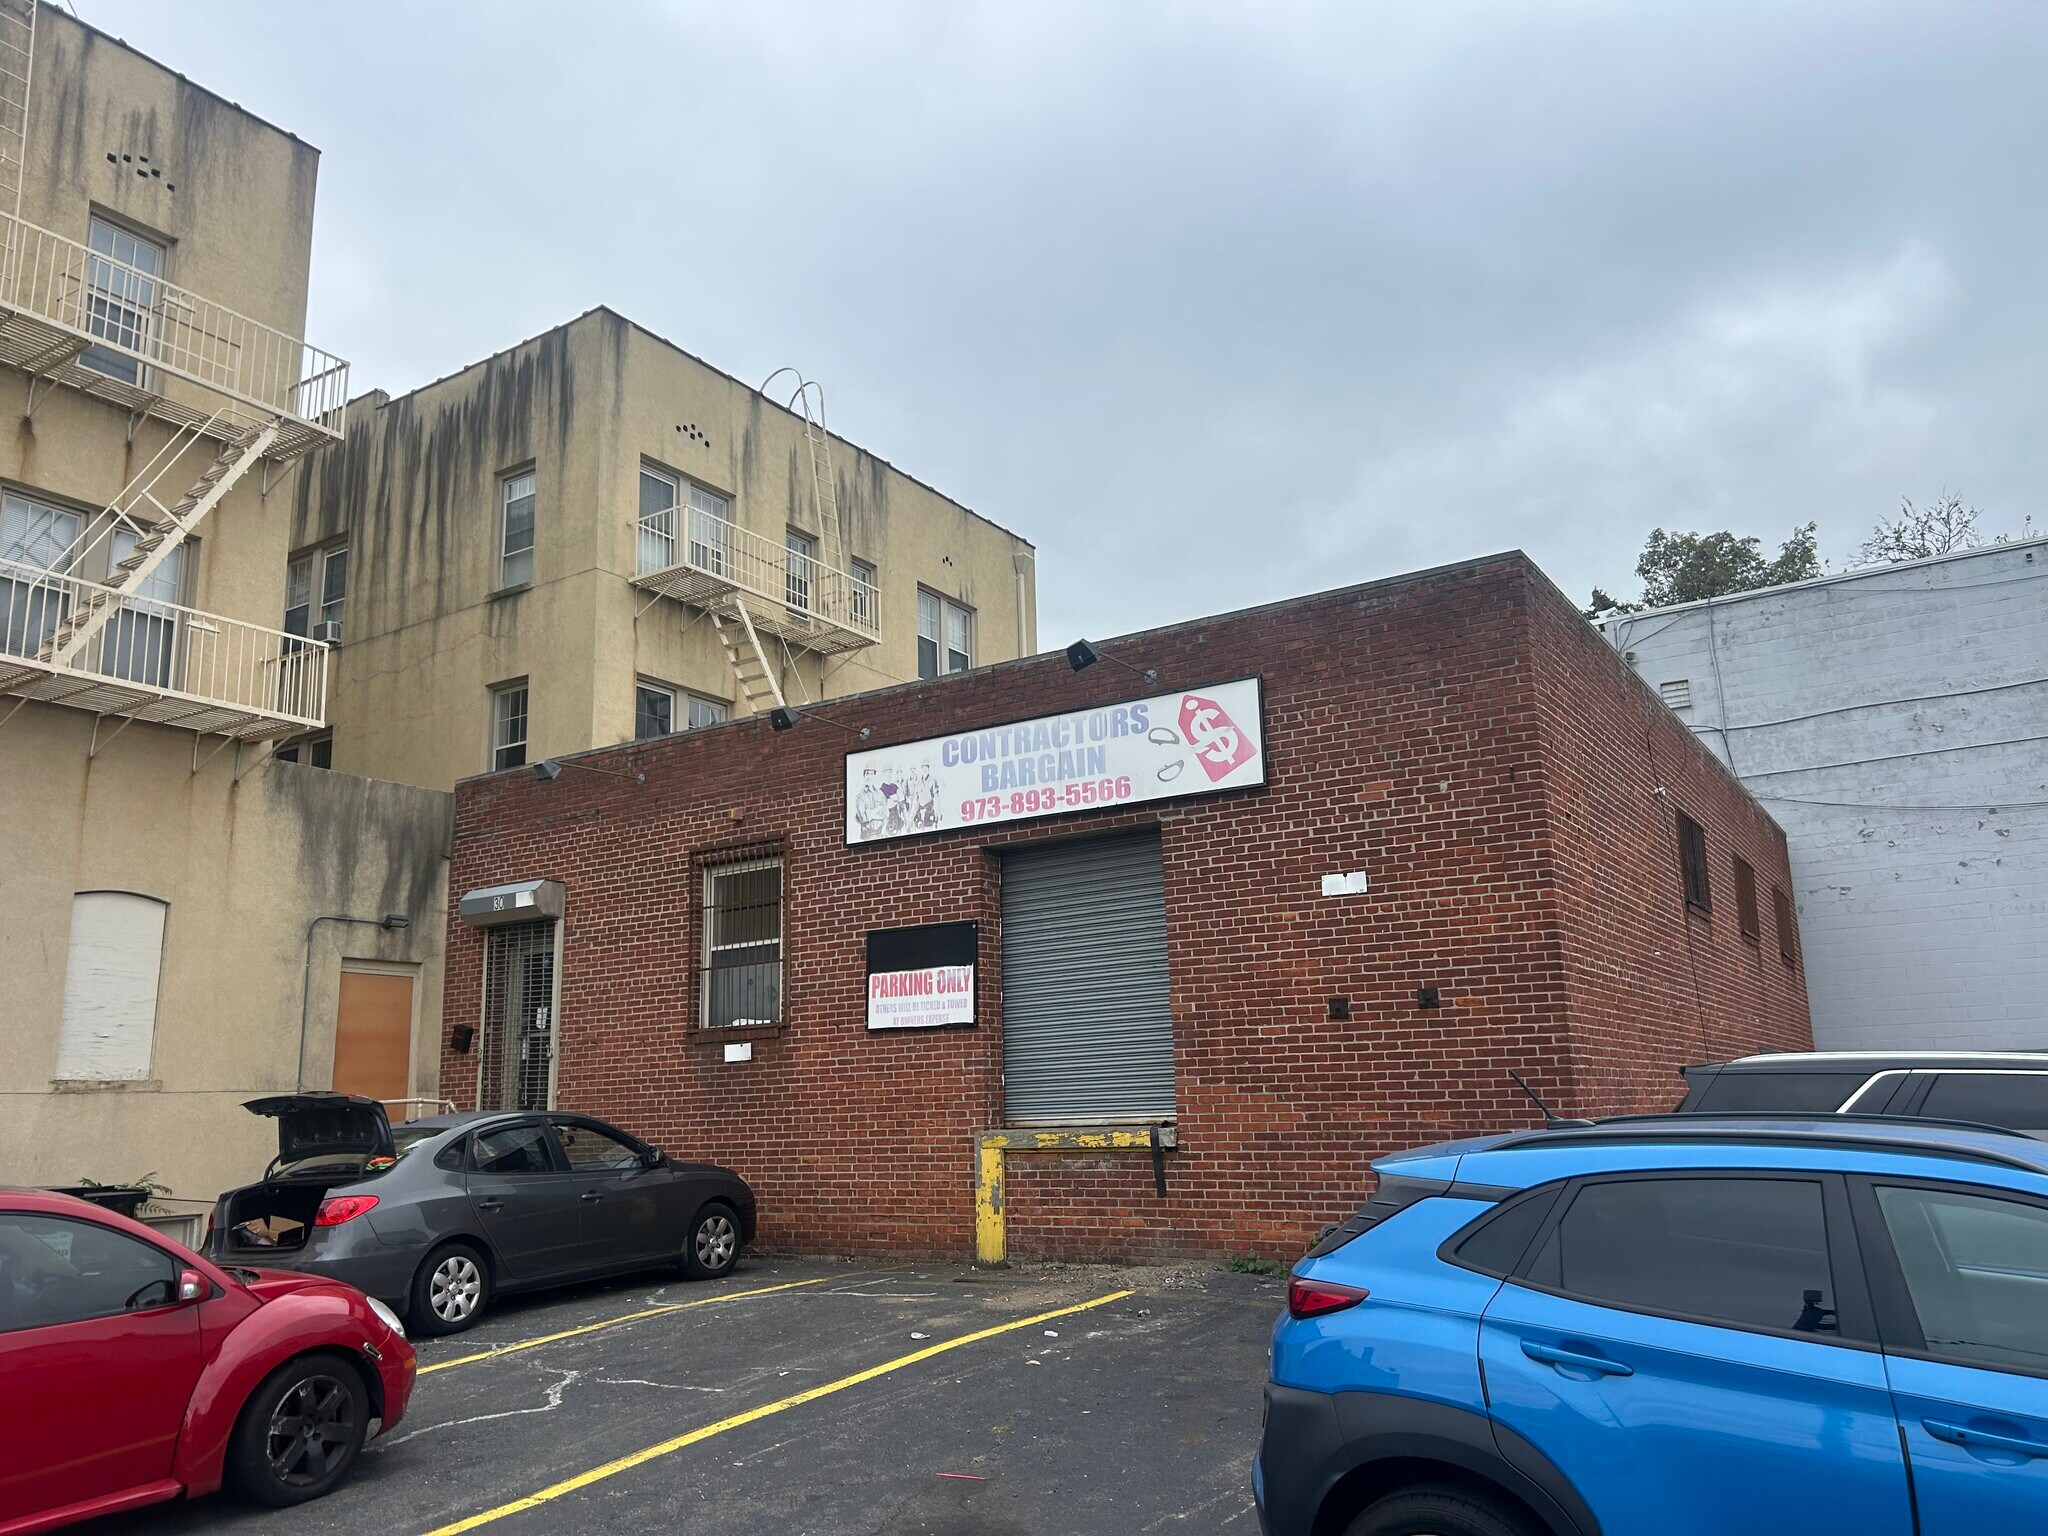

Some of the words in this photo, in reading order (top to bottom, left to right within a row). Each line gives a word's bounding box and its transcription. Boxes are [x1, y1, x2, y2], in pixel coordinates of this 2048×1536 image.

[942, 703, 1150, 767] CONTRACTORS
[981, 745, 1107, 792] BARGAIN
[961, 775, 1131, 822] 973-893-5566
[494, 896, 504, 910] 30
[871, 970, 933, 998] PARKING
[936, 968, 971, 994] ONLY
[876, 1003, 897, 1014] OTHERS
[898, 1002, 911, 1012] WILL
[912, 1001, 919, 1011] BE
[920, 1000, 940, 1011] TICKED
[947, 998, 967, 1009] TOWED
[893, 1016, 899, 1026] AT
[900, 1015, 924, 1026] OWNERS
[925, 1013, 949, 1024] EXPENSE
